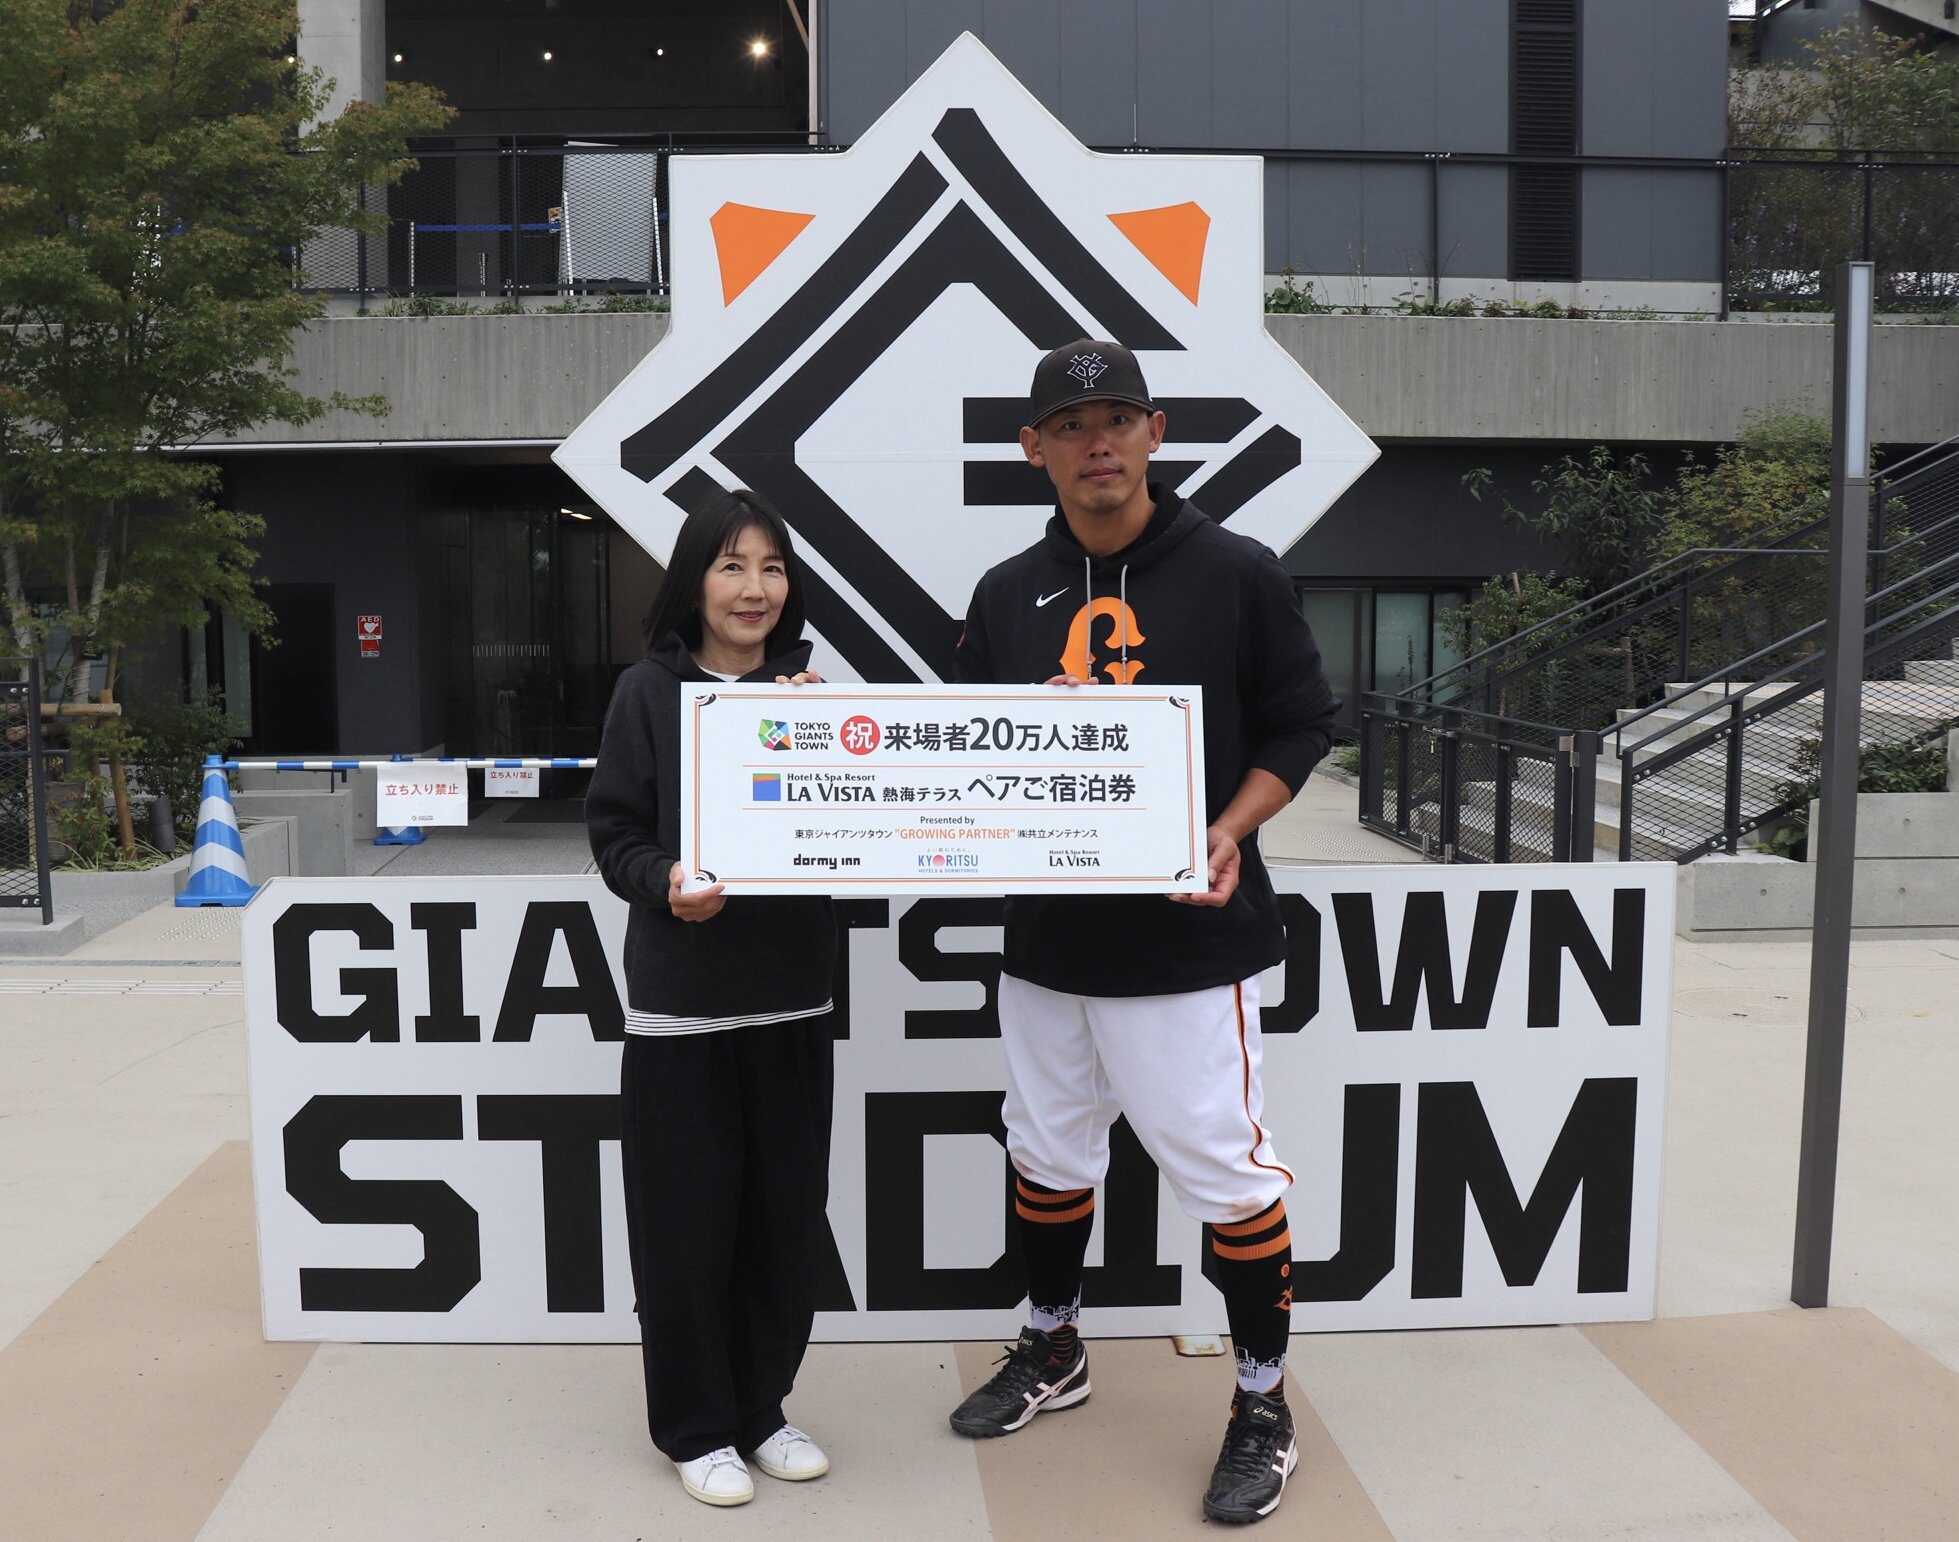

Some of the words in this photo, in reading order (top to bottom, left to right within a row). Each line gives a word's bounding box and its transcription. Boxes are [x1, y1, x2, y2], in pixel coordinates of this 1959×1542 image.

[795, 722, 830, 730] TOKYO
[795, 732, 834, 741] GIANTS
[846, 721, 874, 750] 祝
[884, 717, 1129, 751] 来場者20万人達成
[795, 742, 829, 750] TOWN
[490, 771, 534, 779] 立ち入り禁止
[787, 773, 812, 781] Hotel
[815, 773, 823, 781] &
[825, 773, 842, 783] Spa
[386, 783, 459, 796] 立ち入り禁止
[787, 783, 812, 801] LA
[817, 783, 877, 801] VISTA
[883, 787, 962, 802] 熱海テラス
[967, 774, 1136, 802] ペアご宿泊券
[920, 816, 963, 824] Presented
[964, 816, 975, 825] by
[795, 829, 893, 839] 東京ジャイアンツタウン
[794, 854, 837, 869] dormy
[841, 857, 860, 865] inn
[1049, 856, 1063, 866] LA
[1067, 855, 1100, 866] VISTA
[273, 897, 1004, 1042] GIAS
[283, 1077, 1638, 1313] STDIUM
